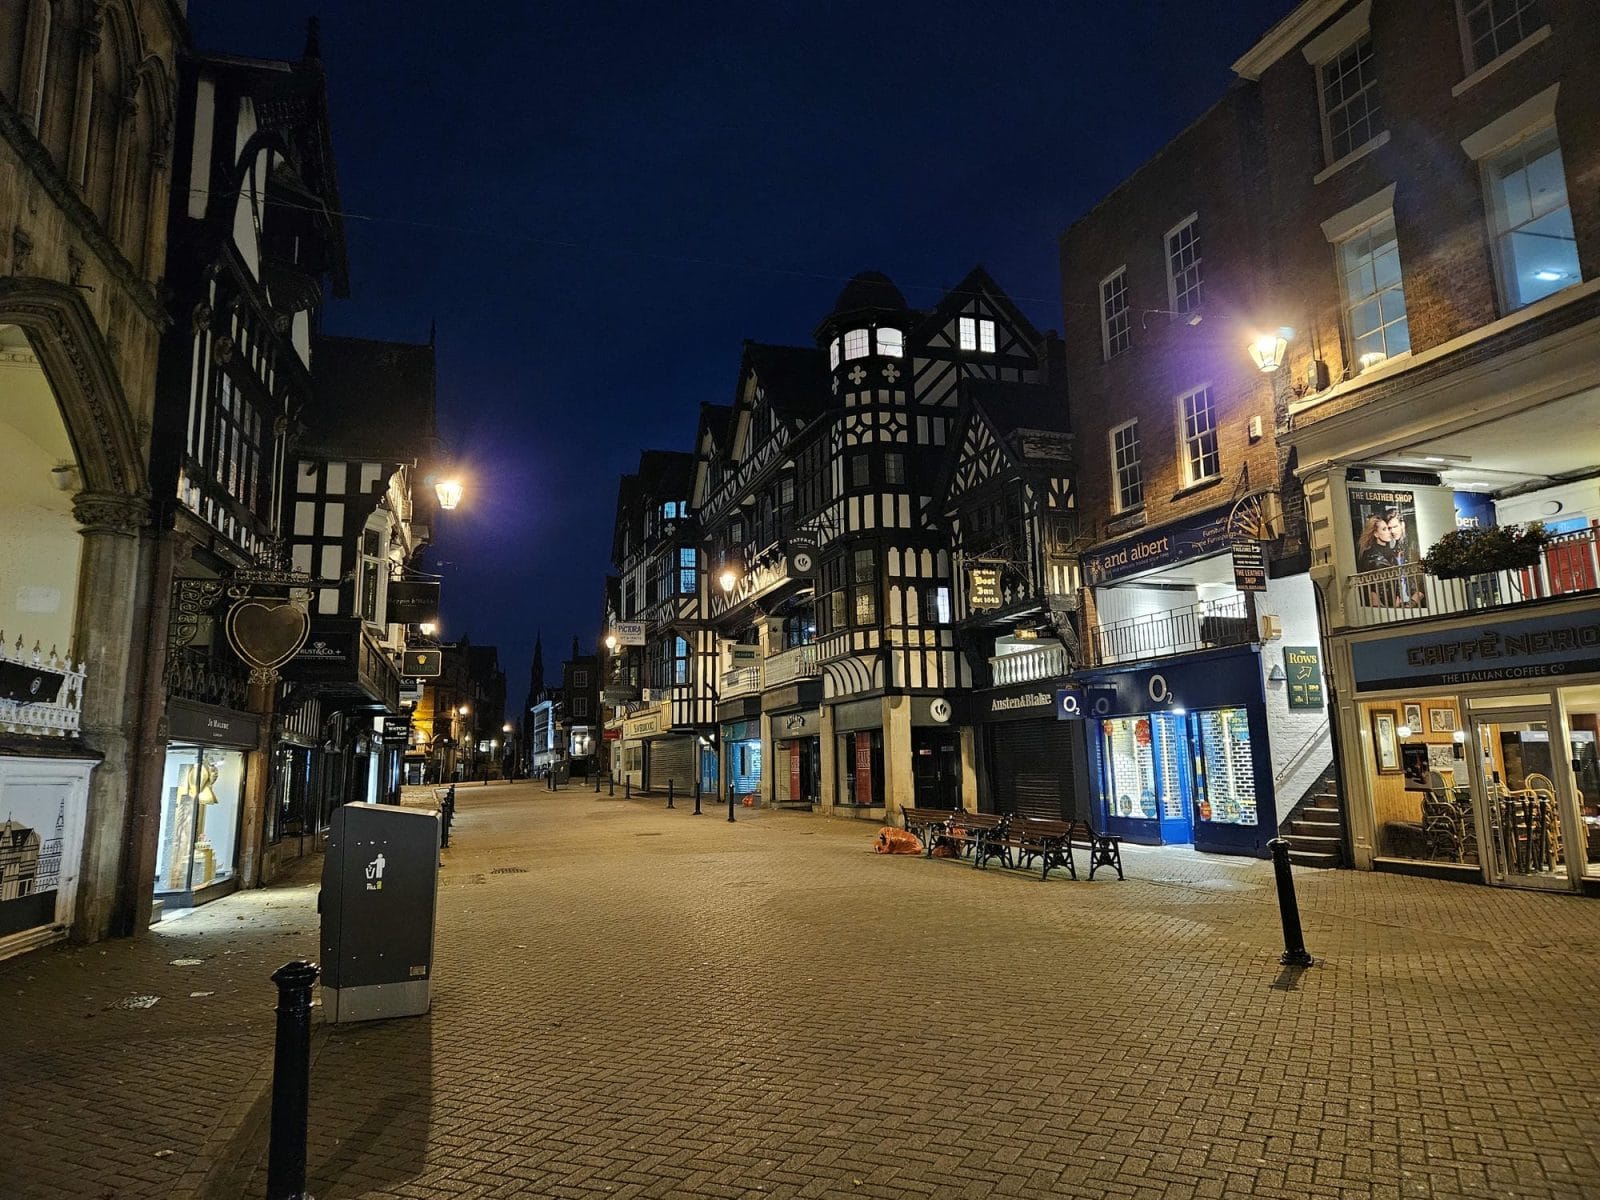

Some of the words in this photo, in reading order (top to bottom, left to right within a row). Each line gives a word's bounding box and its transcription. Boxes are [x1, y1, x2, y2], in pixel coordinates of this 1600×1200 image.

[1351, 491, 1364, 500] THE
[1366, 492, 1394, 502] LEATHER
[1395, 494, 1413, 503] SHOP
[1104, 548, 1128, 569] and
[1130, 536, 1169, 561] albert
[1504, 624, 1600, 657] NERO
[1442, 674, 1461, 683] THE
[1462, 669, 1503, 682] ITALIAN
[1505, 665, 1546, 678] COFFEE
[1148, 674, 1173, 705] O2
[991, 692, 1052, 711] Austen&Blake
[1063, 696, 1080, 715] O2
